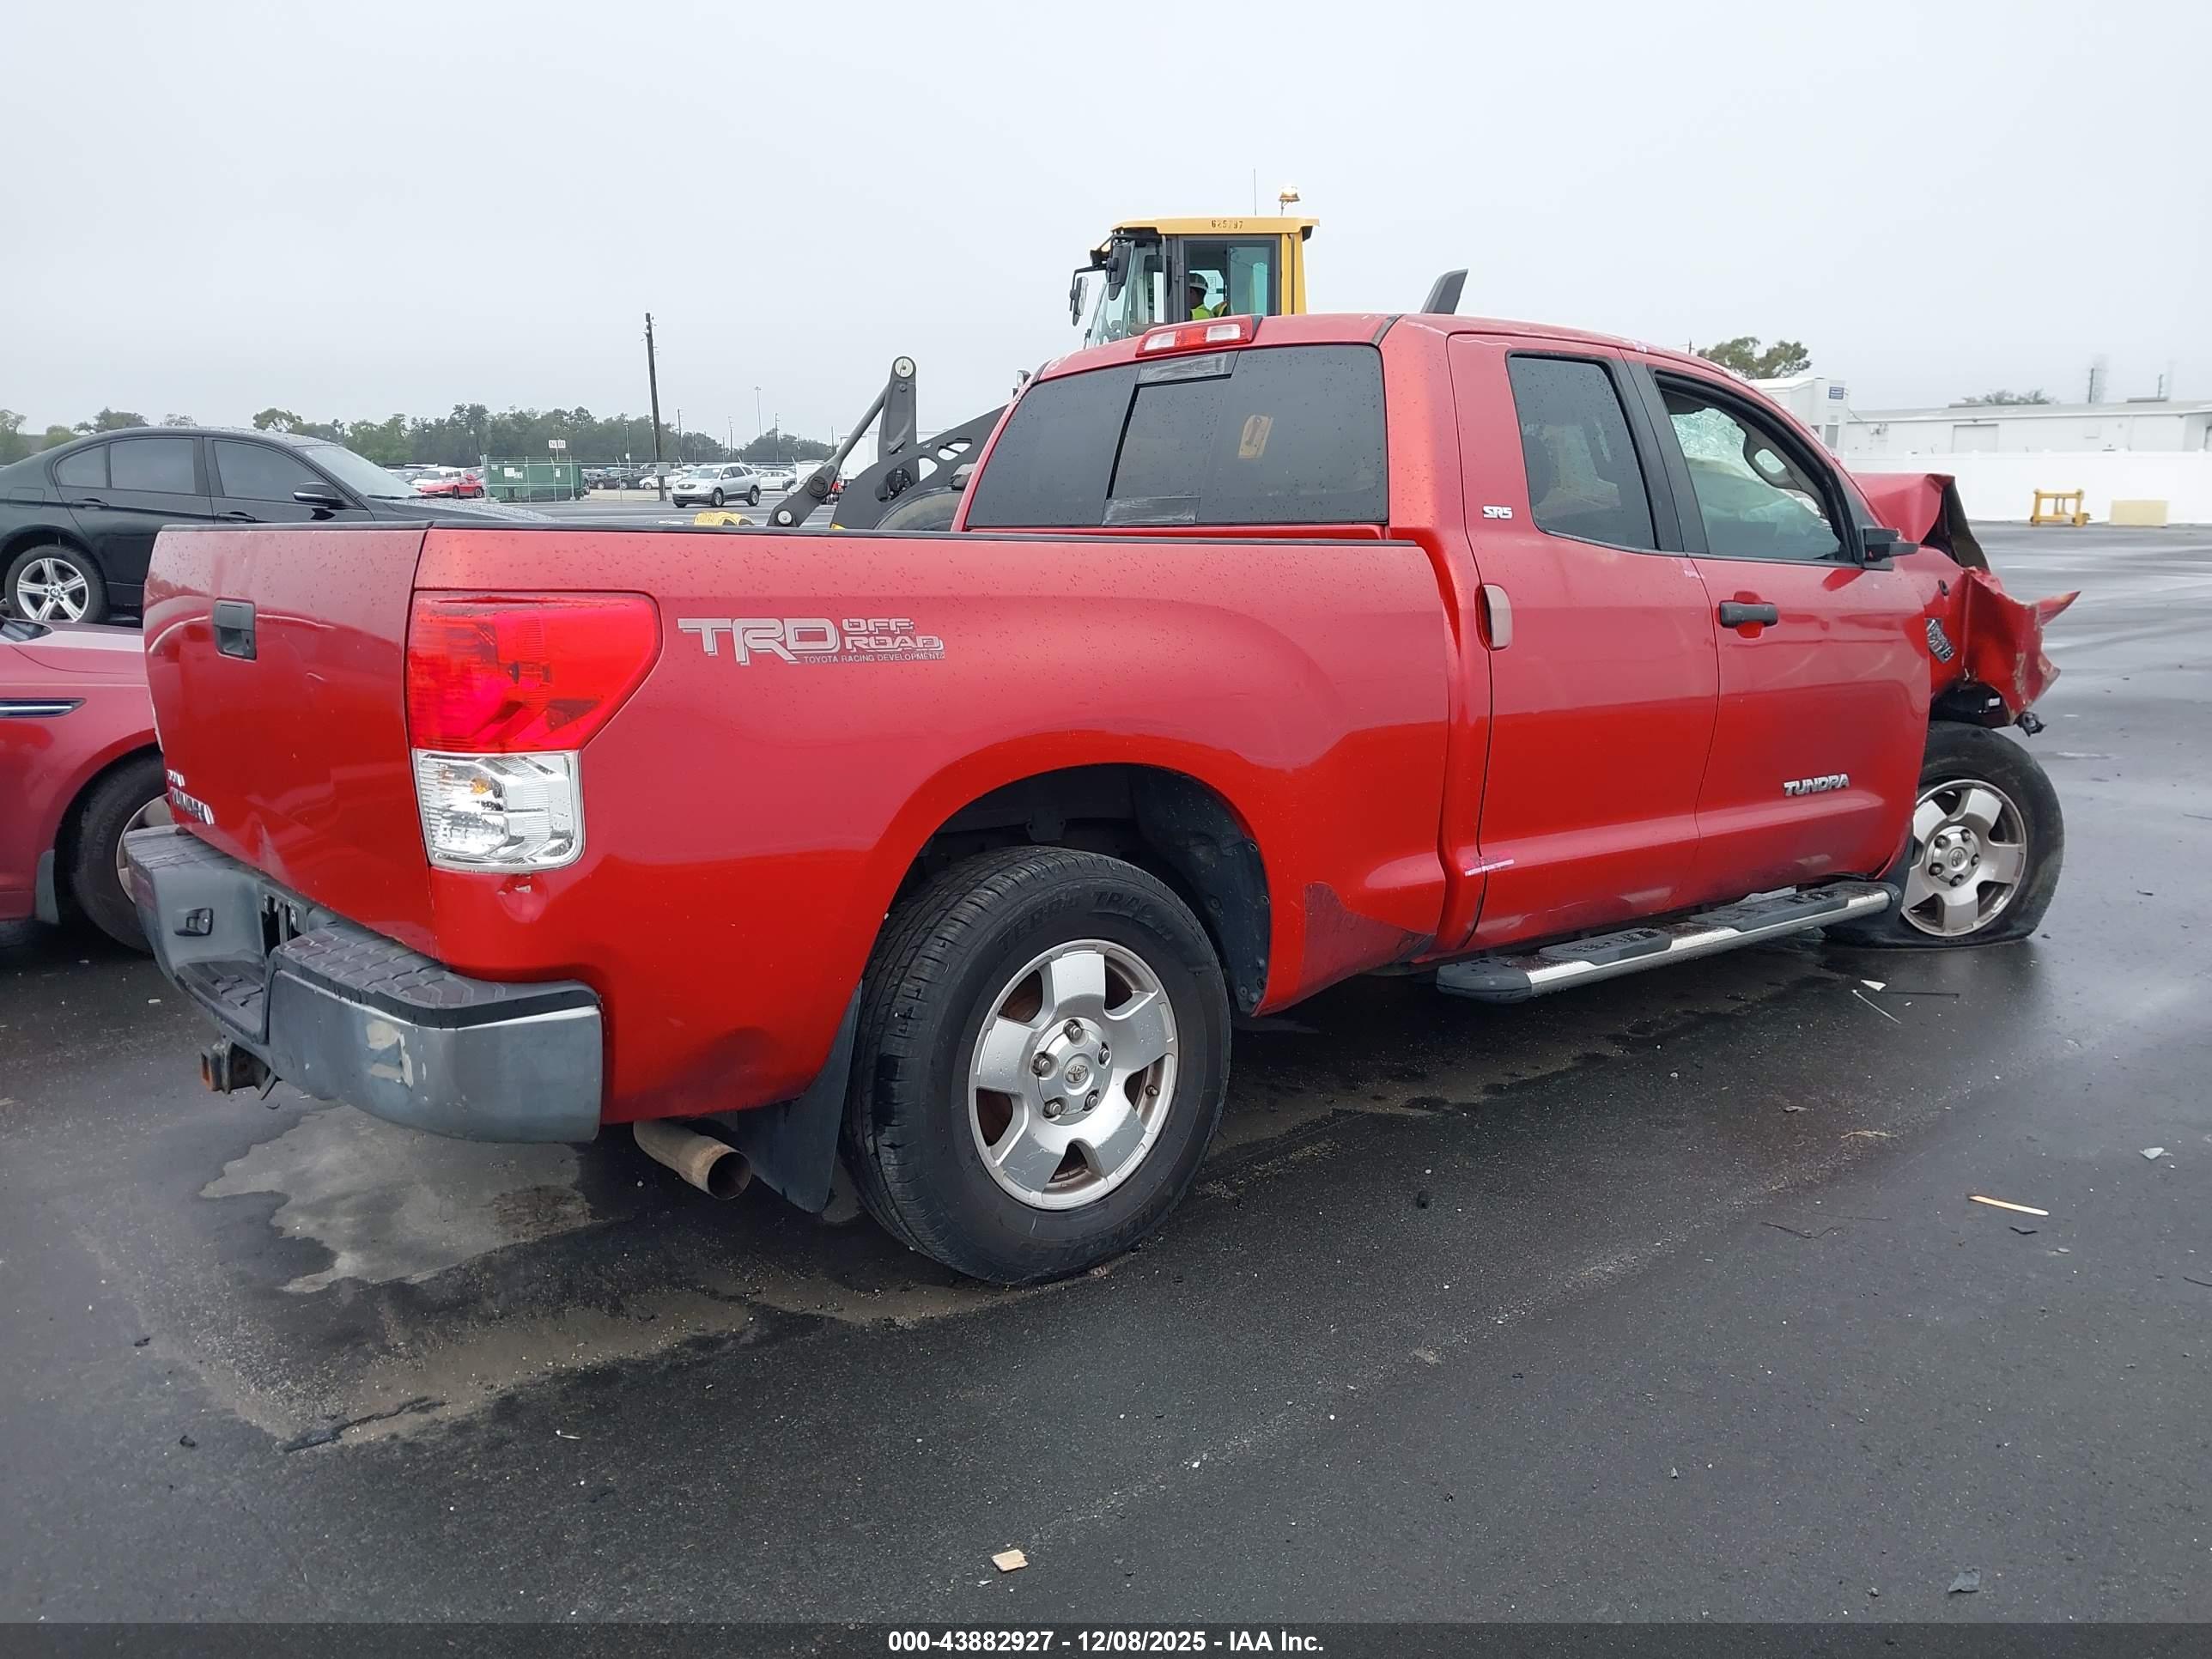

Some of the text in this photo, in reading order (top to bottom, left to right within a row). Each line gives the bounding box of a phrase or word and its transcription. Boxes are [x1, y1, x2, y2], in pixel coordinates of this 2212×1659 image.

[1483, 505, 1513, 520] SR5
[842, 617, 914, 633] OFF
[678, 617, 840, 666] TRD
[843, 635, 944, 653] ROAD
[804, 655, 839, 664] TOYOTA
[841, 653, 875, 663] RACING
[1784, 773, 1850, 797] TUNDRA
